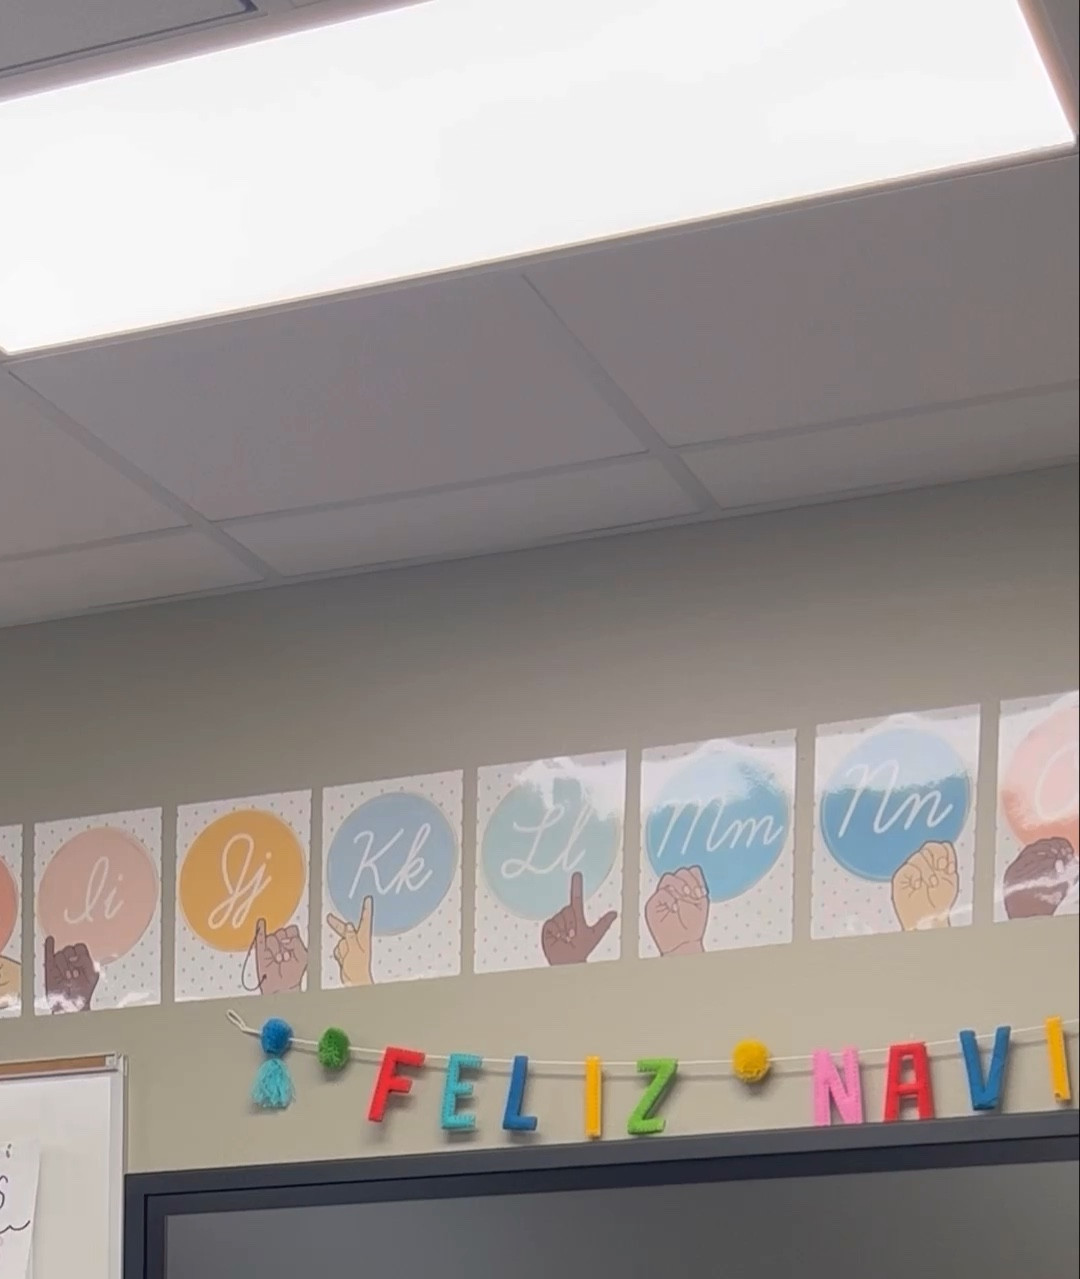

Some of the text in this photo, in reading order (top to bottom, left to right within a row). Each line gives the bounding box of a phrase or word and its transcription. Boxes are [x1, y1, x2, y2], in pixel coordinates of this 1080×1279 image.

[657, 796, 784, 859] Mm
[838, 759, 954, 838] Nn
[348, 823, 432, 900] Kk
[501, 802, 592, 879] Ll
[64, 856, 126, 926] Ii
[208, 833, 273, 930] Jj
[367, 1016, 1072, 1140] FELIZ NAVI
